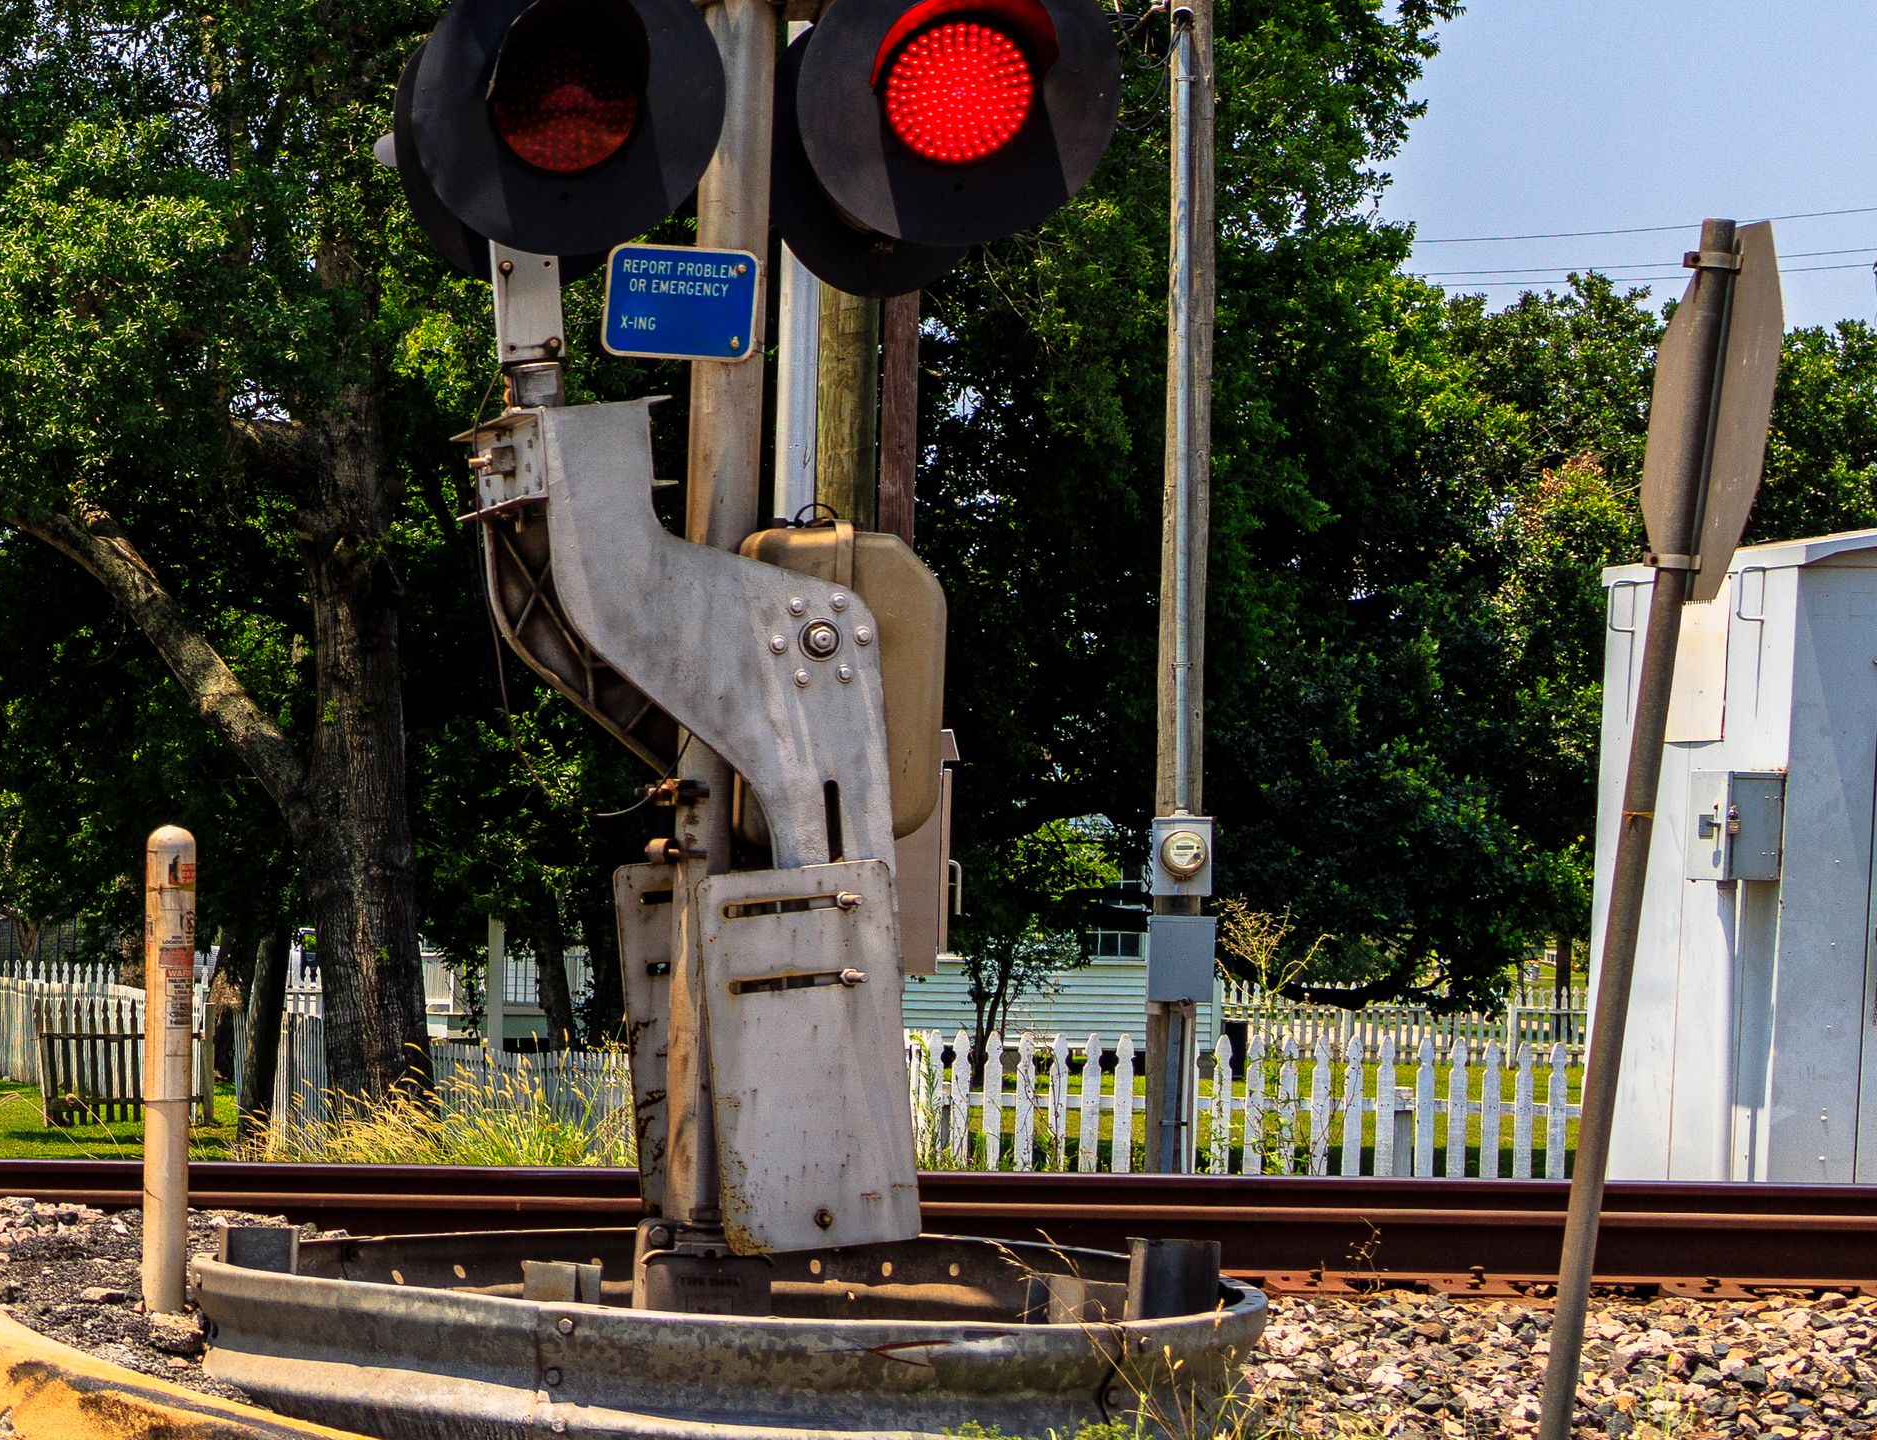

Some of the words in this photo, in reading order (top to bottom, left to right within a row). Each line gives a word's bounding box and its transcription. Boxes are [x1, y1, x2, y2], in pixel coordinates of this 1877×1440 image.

[623, 259, 673, 275] REPORT
[677, 262, 738, 279] PROBLEM
[629, 278, 647, 292] OR
[651, 280, 729, 297] EMERGENCY
[620, 315, 657, 330] X-ING
